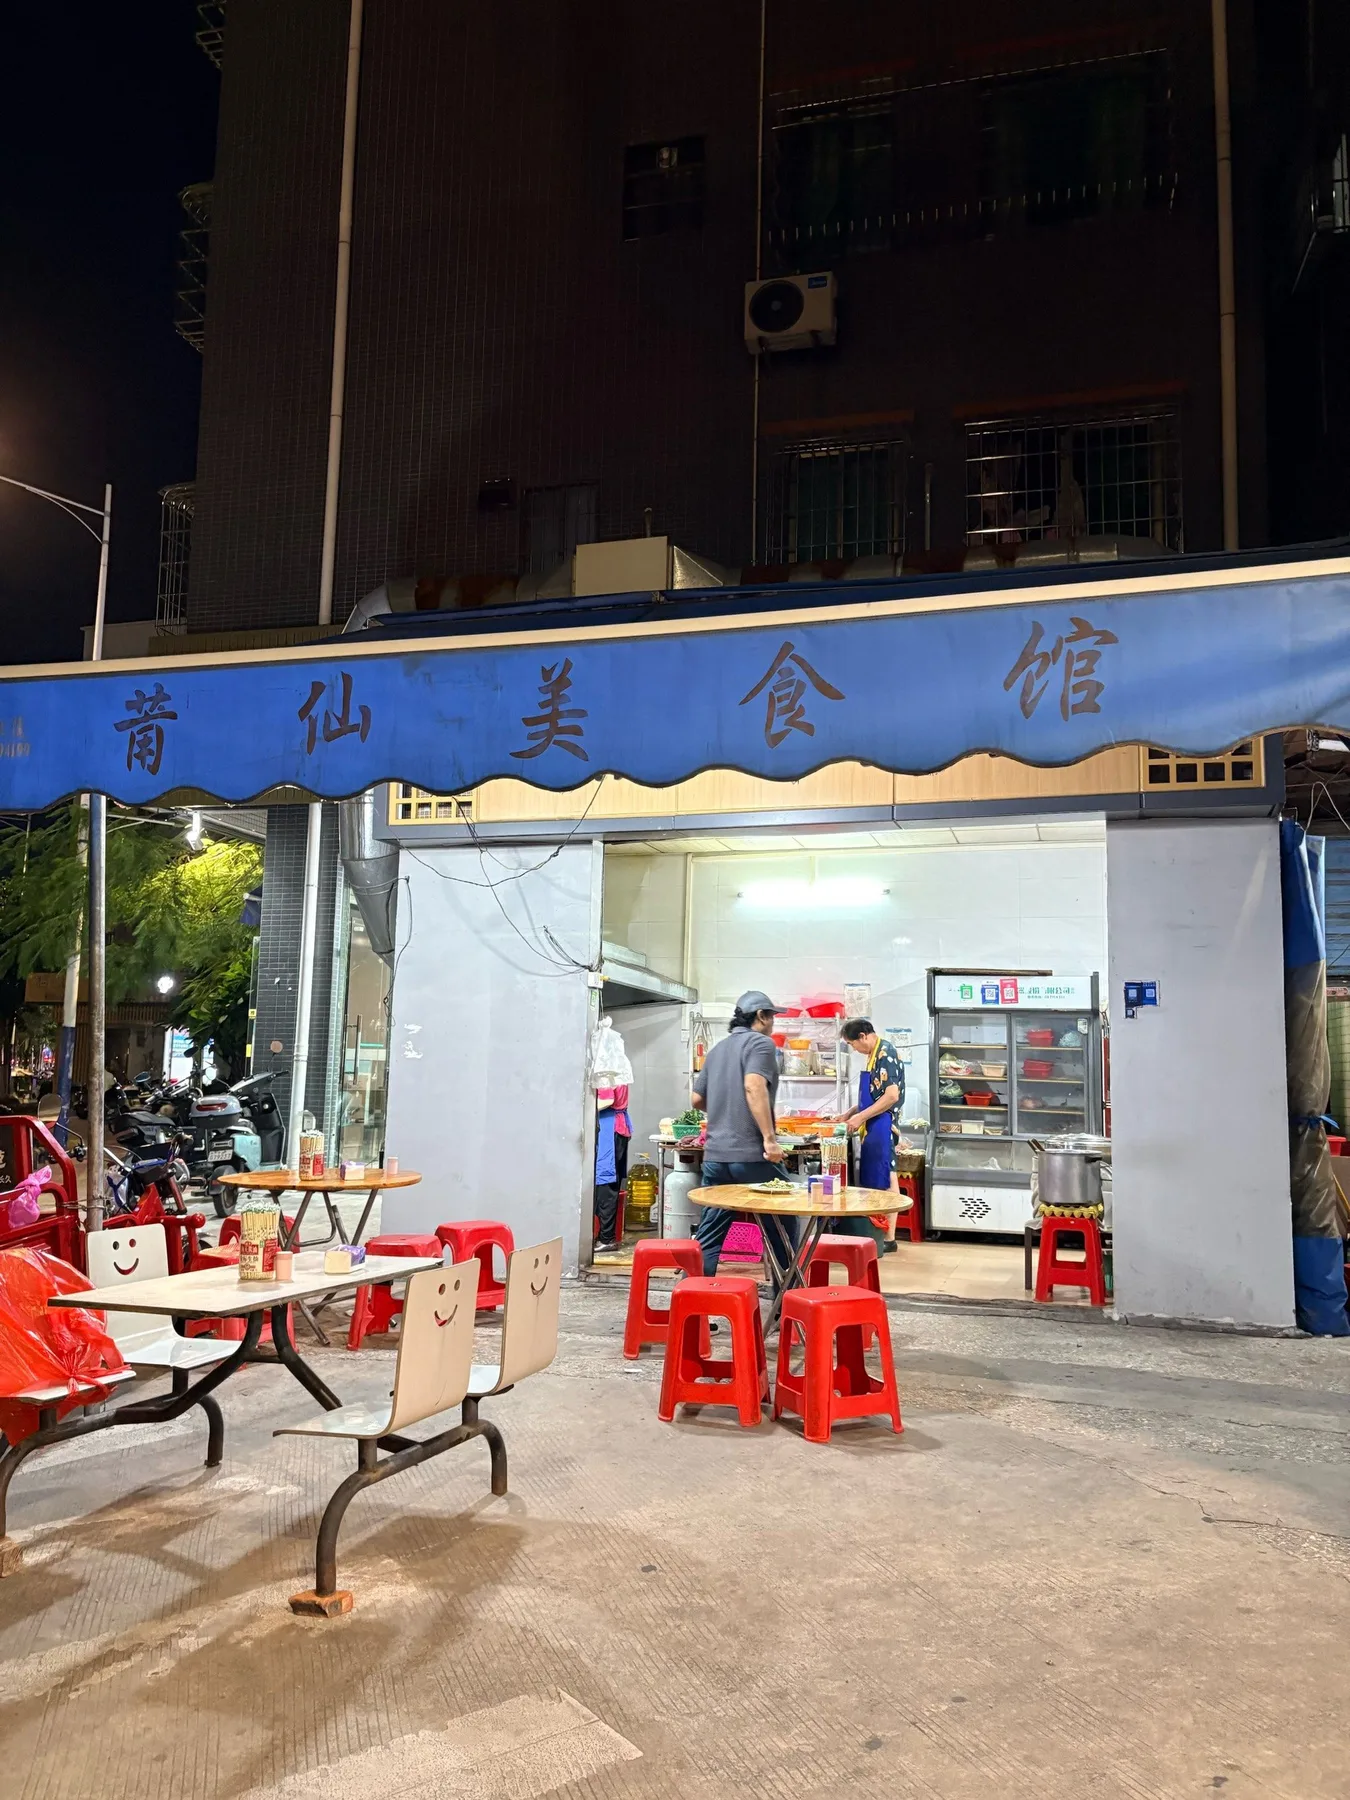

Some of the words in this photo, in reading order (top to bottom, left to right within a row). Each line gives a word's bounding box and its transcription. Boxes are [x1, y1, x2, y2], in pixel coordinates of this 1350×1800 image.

[114, 616, 1119, 776] 莆仙美食馆
